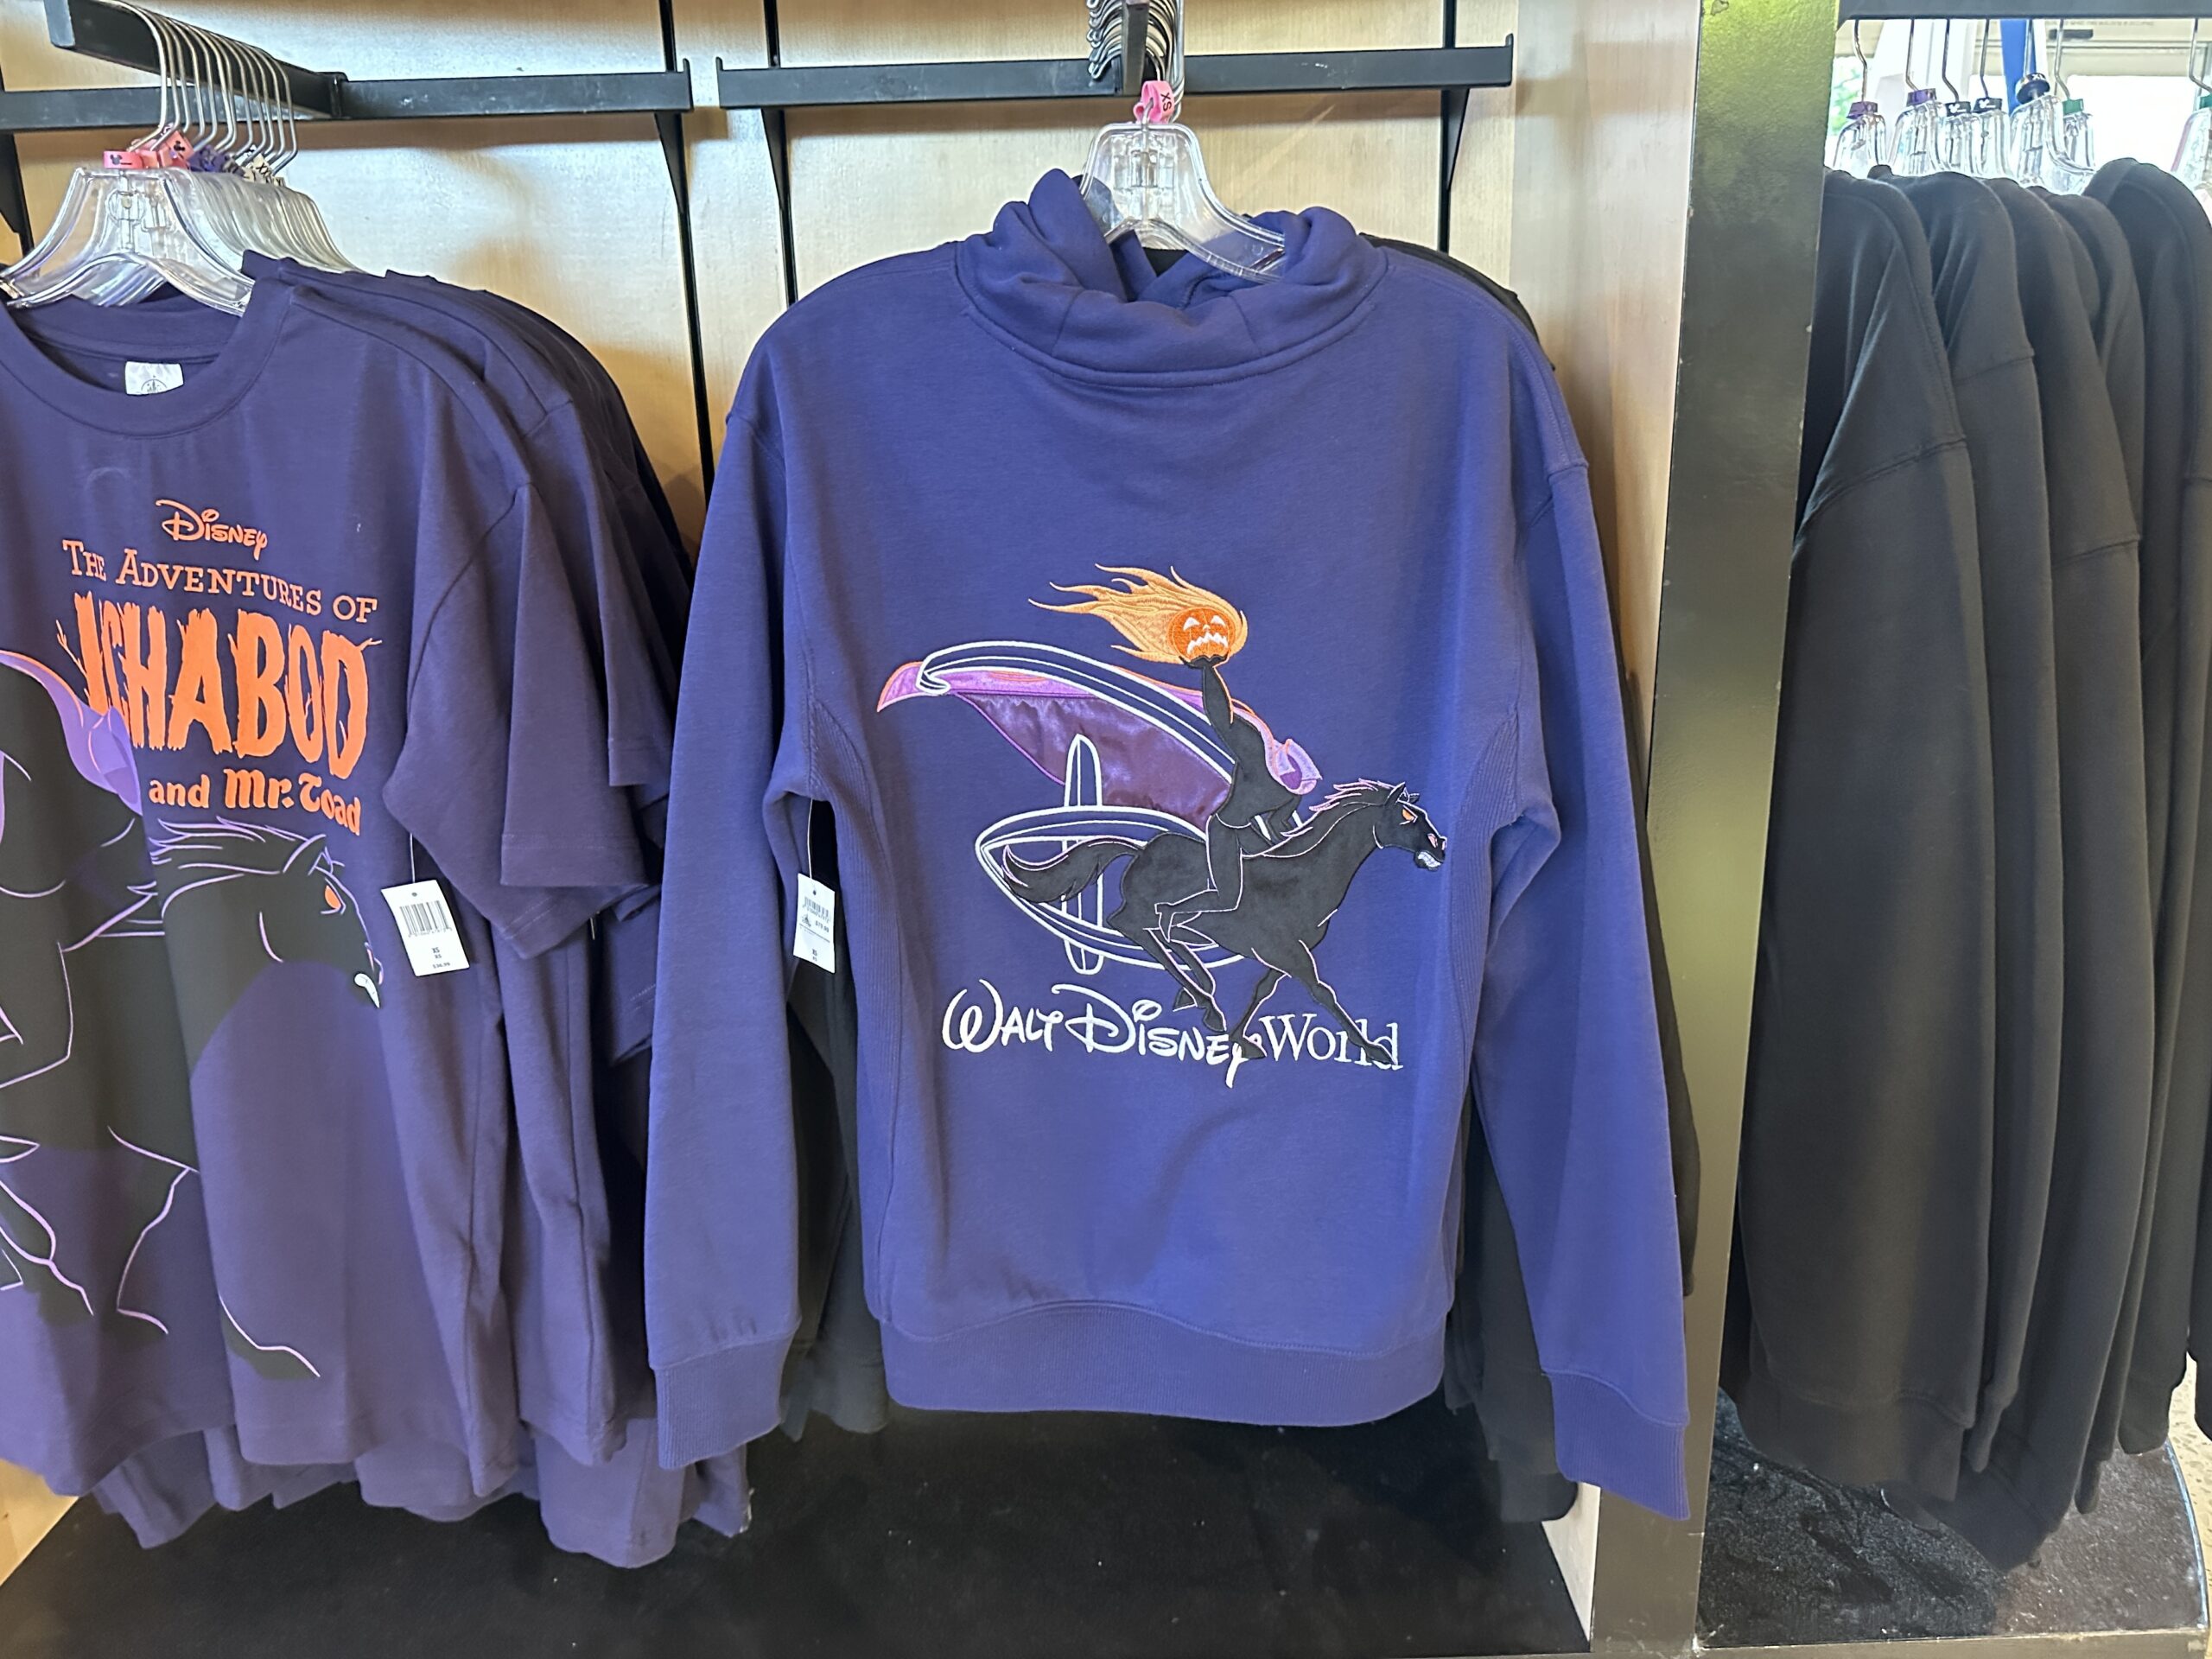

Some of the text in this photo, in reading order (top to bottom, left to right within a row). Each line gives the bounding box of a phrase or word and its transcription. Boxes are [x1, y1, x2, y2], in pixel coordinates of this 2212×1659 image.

[1160, 92, 1173, 111] XS
[67, 591, 377, 779] ICHABOD
[149, 769, 361, 836] and Mr. Toad
